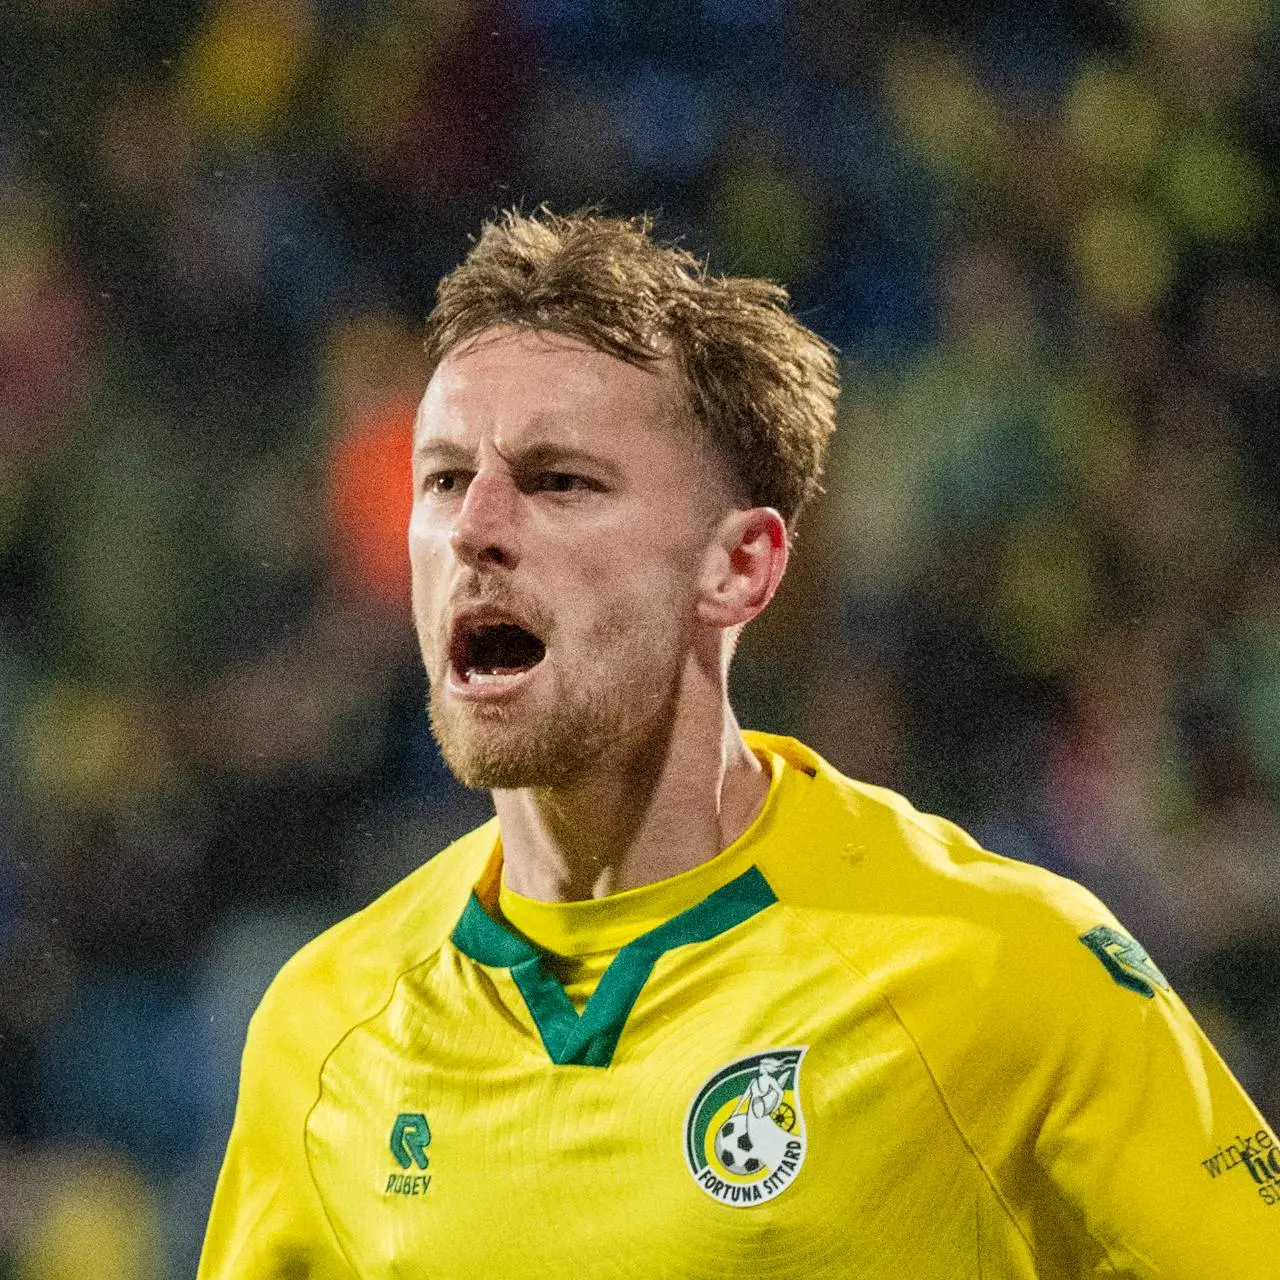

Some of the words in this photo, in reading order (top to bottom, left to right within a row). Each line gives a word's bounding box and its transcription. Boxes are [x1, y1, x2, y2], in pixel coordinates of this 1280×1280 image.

[385, 1174, 432, 1195] ROBEY
[698, 1169, 762, 1202] FORTUNA
[763, 1140, 802, 1194] SITTARD
